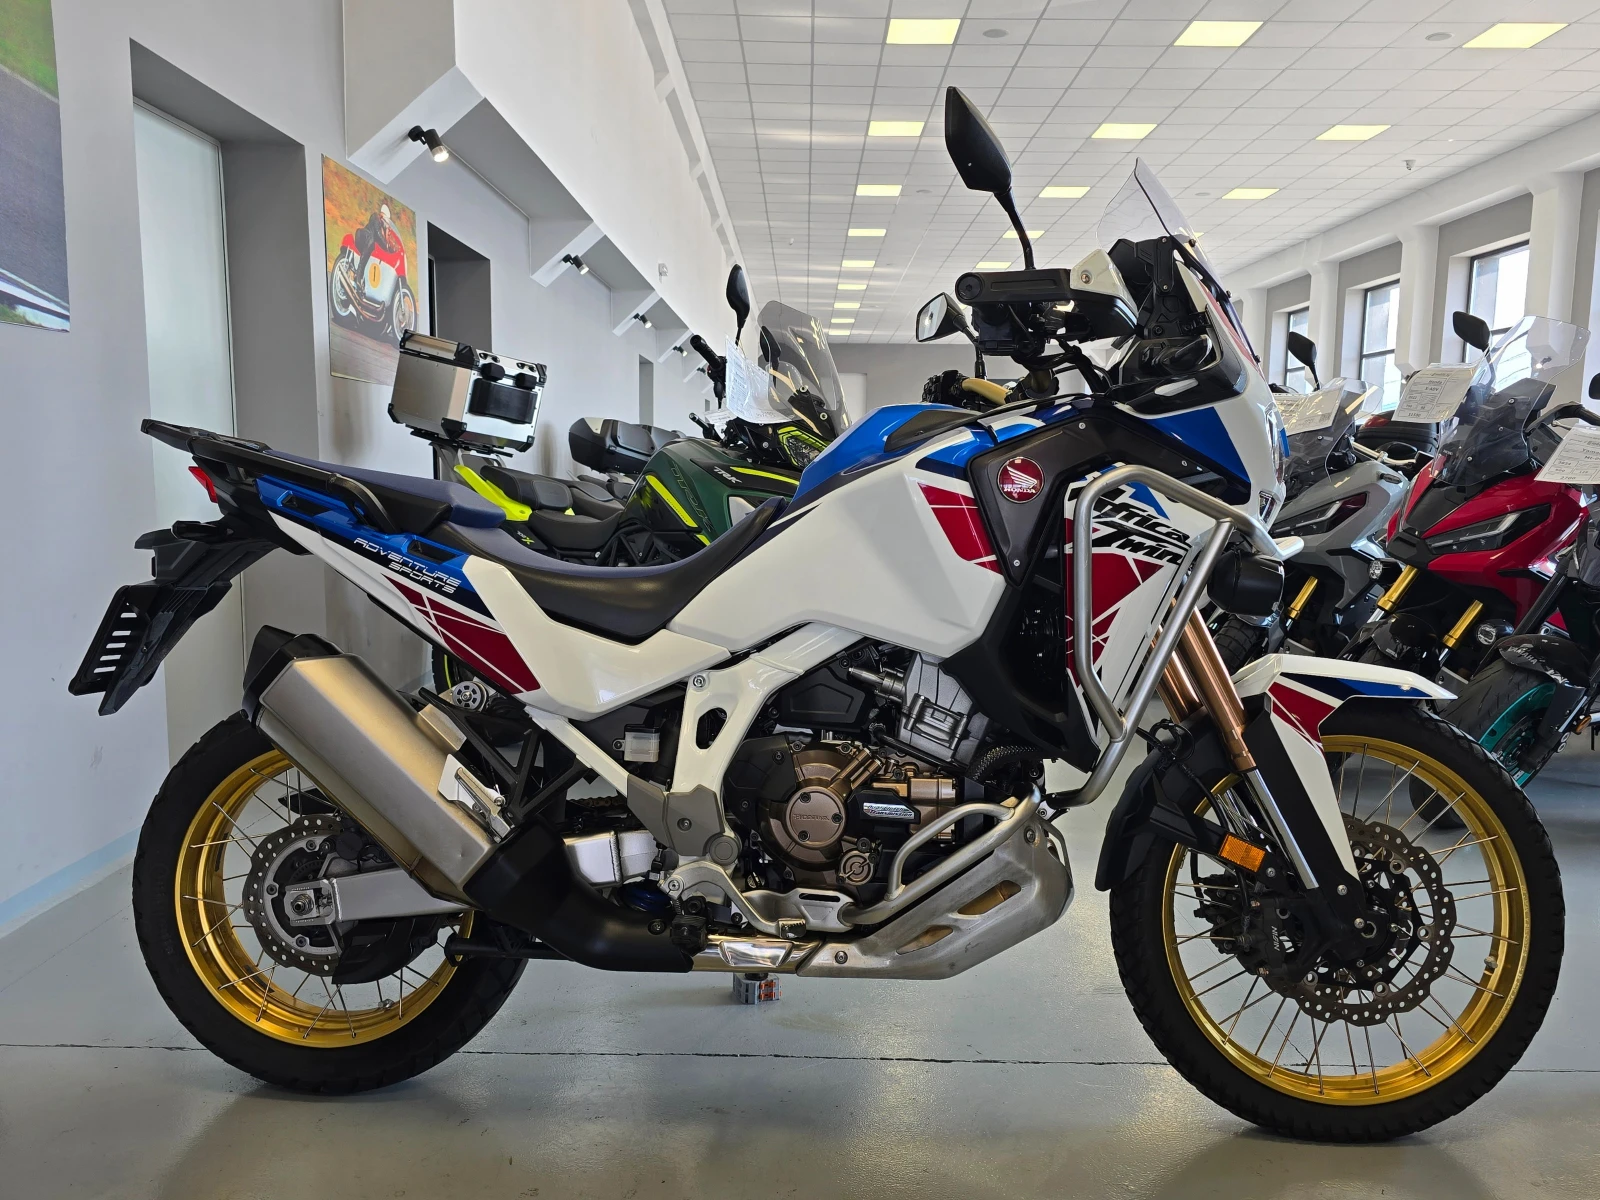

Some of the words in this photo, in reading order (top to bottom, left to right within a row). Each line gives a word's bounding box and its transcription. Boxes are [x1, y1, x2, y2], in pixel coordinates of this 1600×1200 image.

[713, 465, 743, 484] TRK
[353, 537, 462, 588] ADVENTURE
[388, 561, 457, 594] SPORTS
[1507, 646, 1538, 665] YAMAHA
